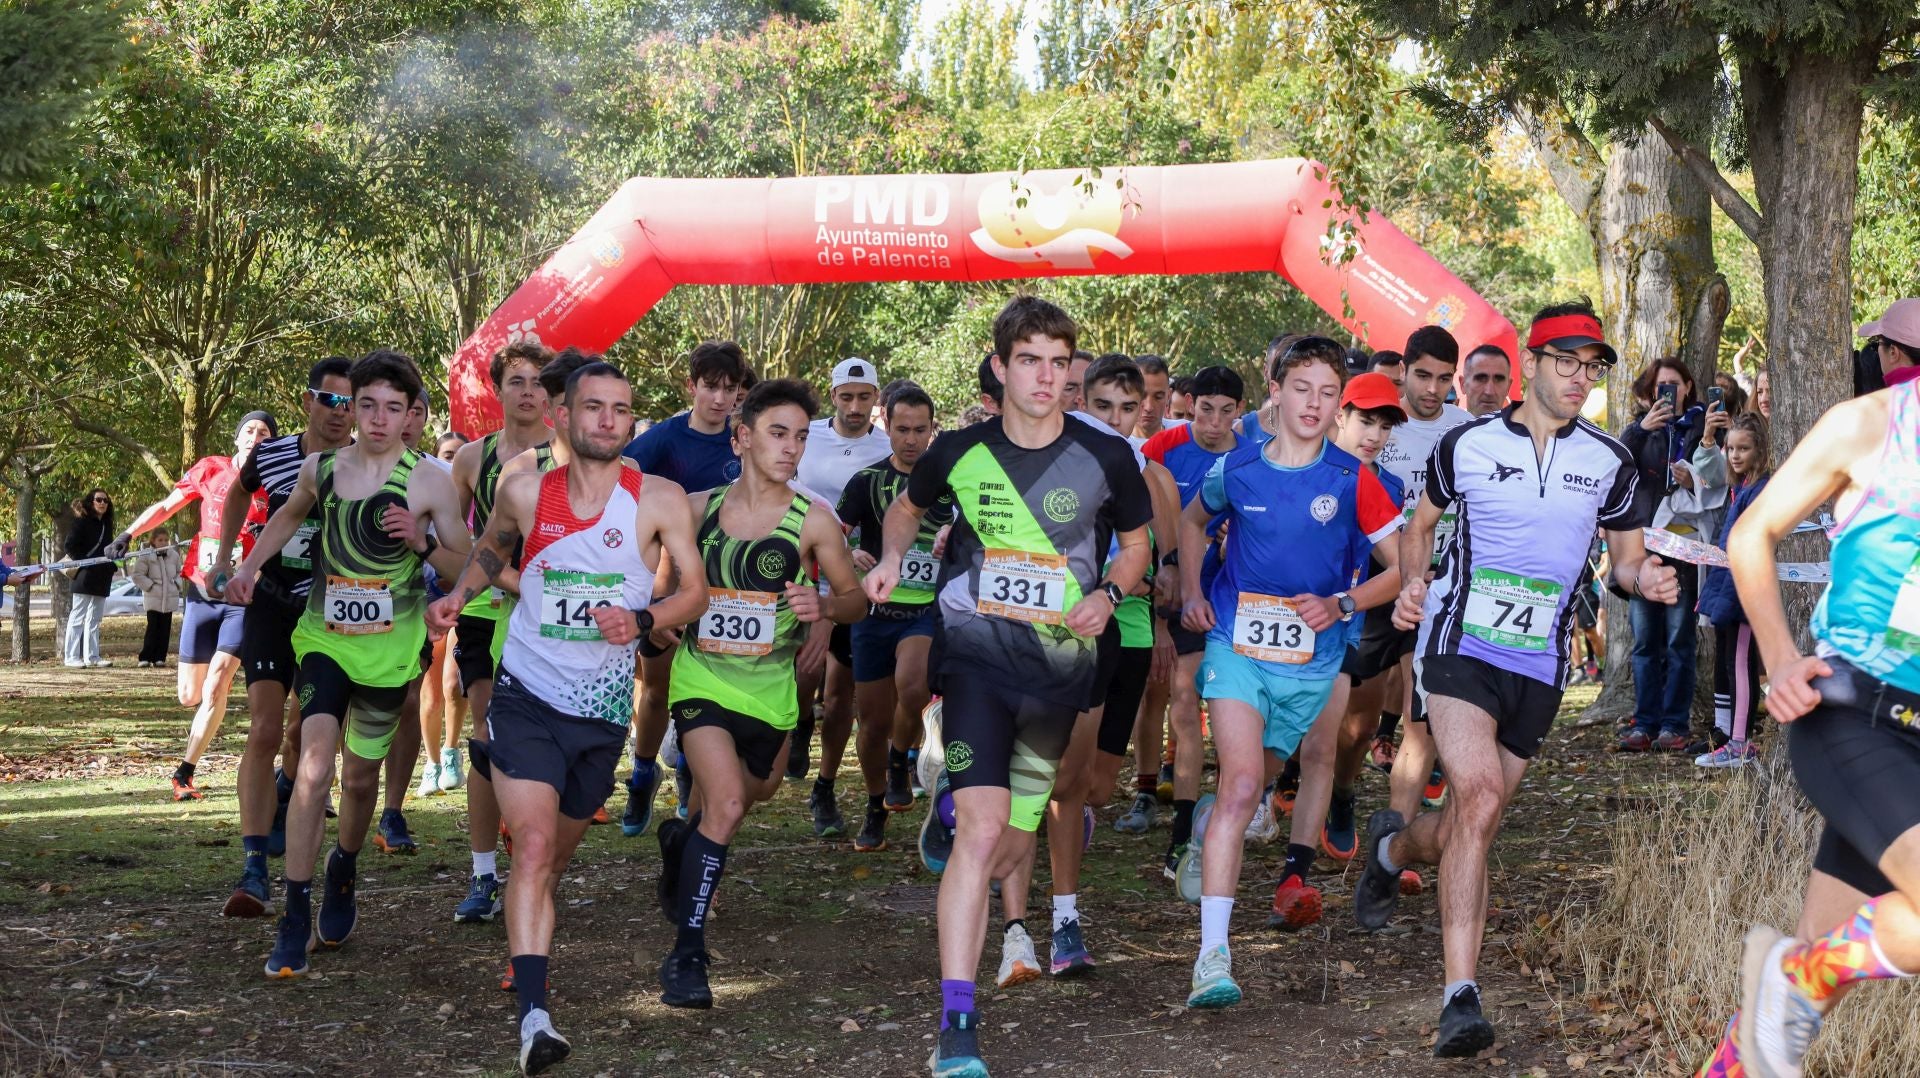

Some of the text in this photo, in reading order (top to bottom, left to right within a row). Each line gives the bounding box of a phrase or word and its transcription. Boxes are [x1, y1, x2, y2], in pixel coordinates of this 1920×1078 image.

[814, 180, 950, 226] PMD
[815, 224, 948, 248] Ayuntamiento
[817, 246, 951, 268] de Palencia
[1411, 470, 1428, 482] TR
[1563, 473, 1600, 488] ORCA
[978, 509, 1013, 519] deportes
[540, 522, 566, 533] SALTO
[900, 561, 933, 581] 93
[992, 576, 1048, 607] 331
[333, 600, 380, 622] 300
[1492, 600, 1534, 633] 74
[709, 613, 761, 640] 330
[1247, 620, 1302, 648] 313
[688, 854, 720, 928] kalenji
